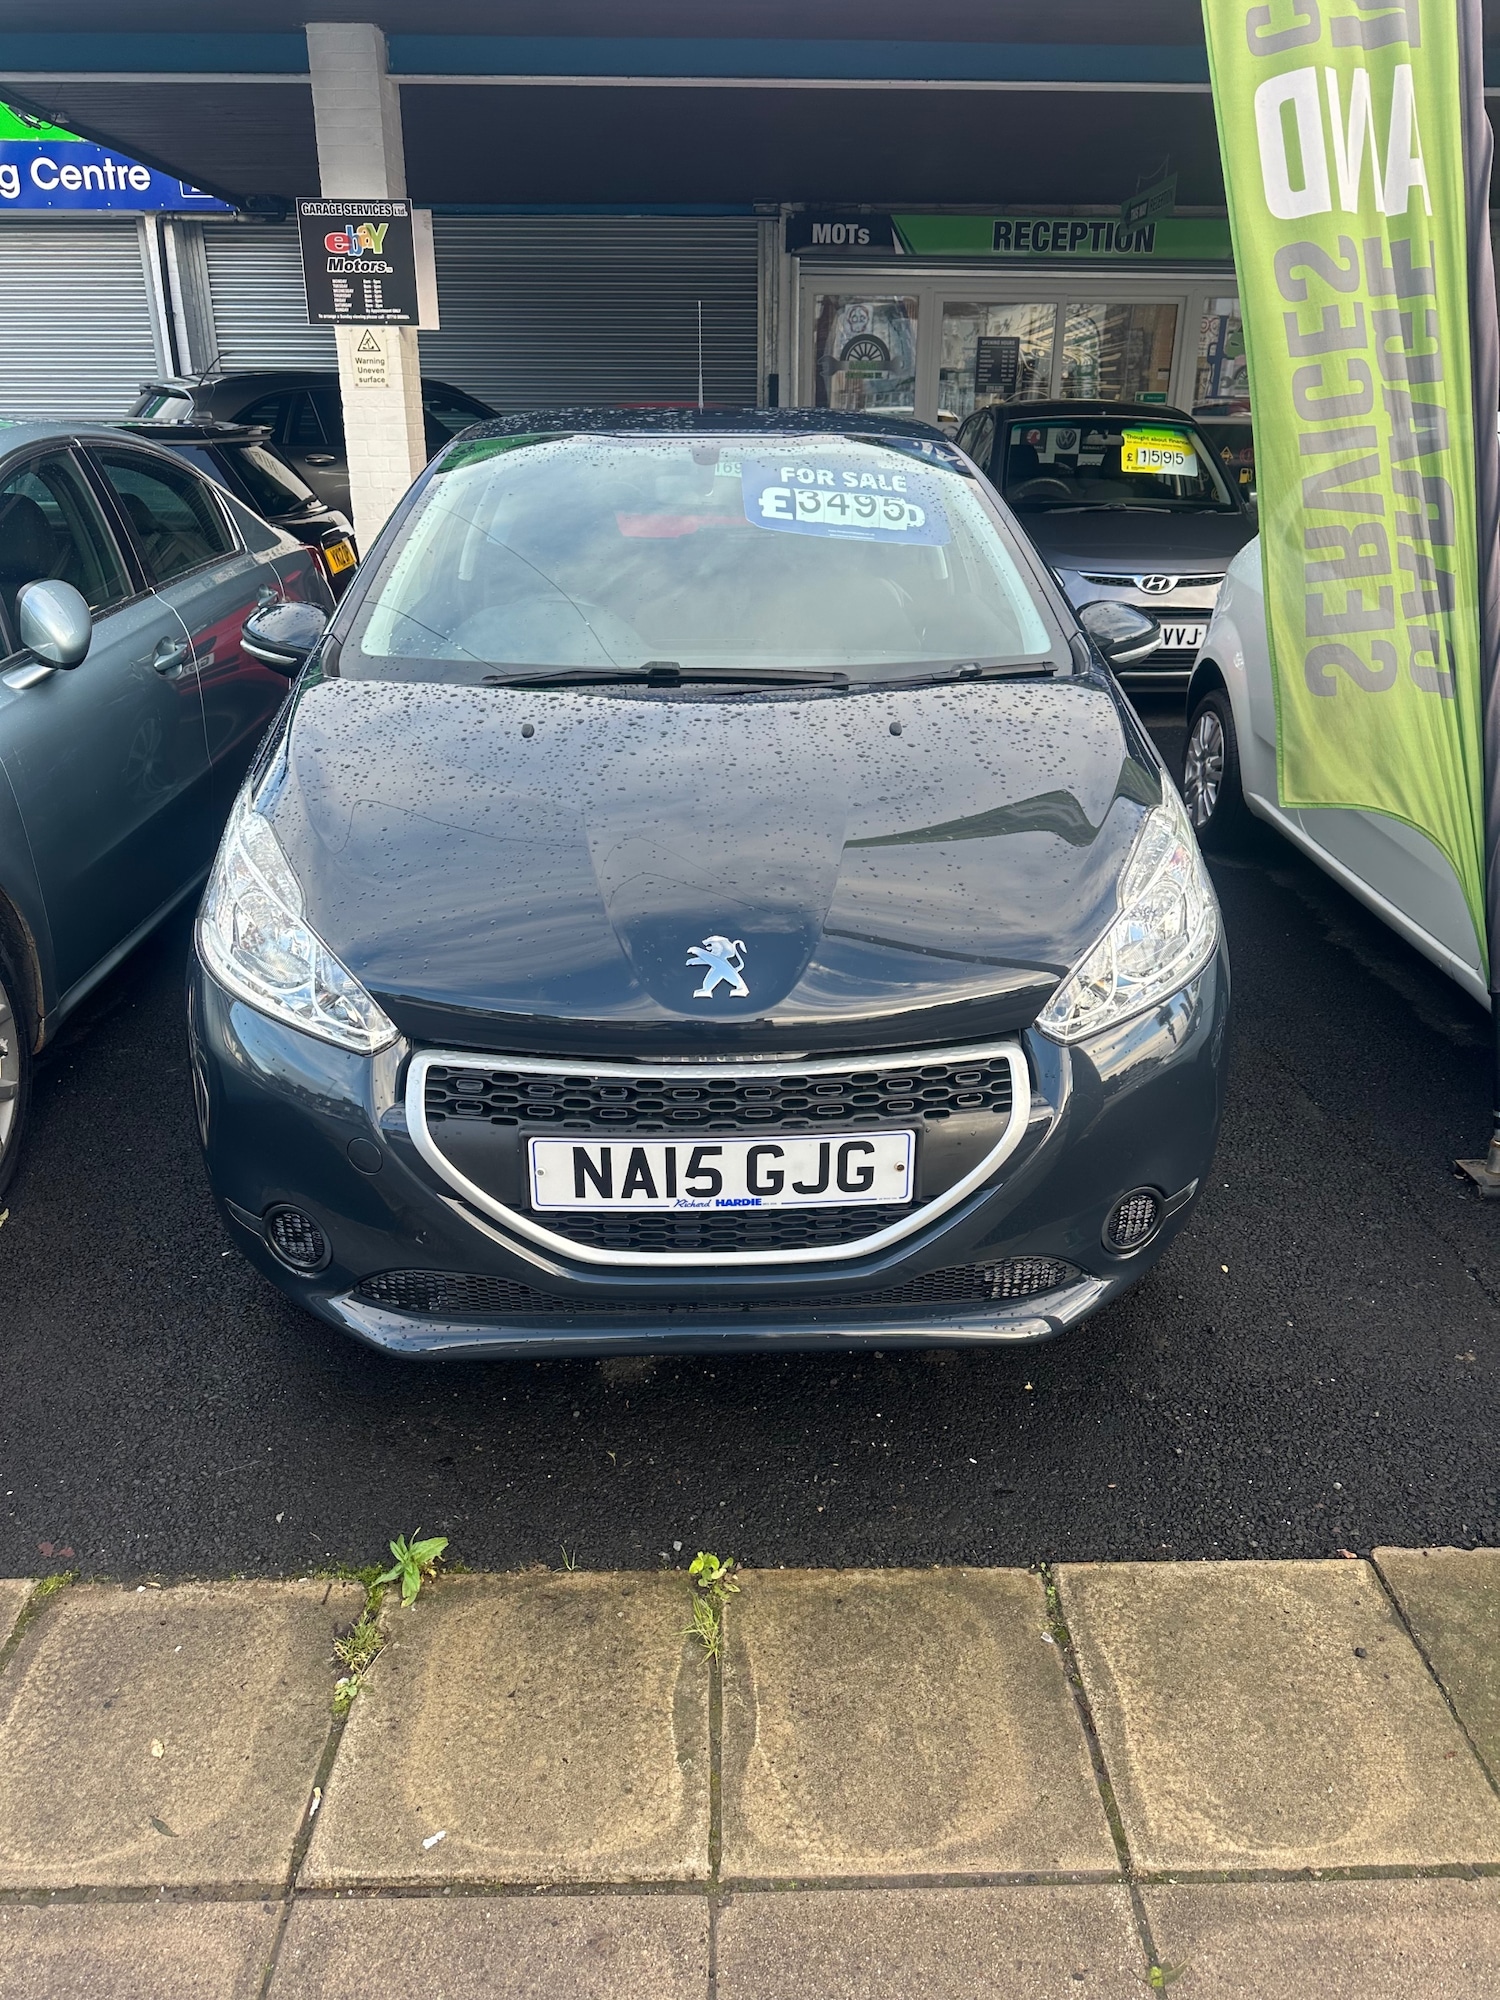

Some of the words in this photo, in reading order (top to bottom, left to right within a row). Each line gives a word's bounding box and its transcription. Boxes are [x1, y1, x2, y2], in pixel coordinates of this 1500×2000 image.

[30, 156, 151, 191] Centre
[301, 203, 343, 216] GARAGE
[344, 203, 391, 217] SERVICES
[812, 223, 870, 245] MOTs
[993, 220, 1157, 253] RECEPTION
[327, 257, 387, 273] Motors
[355, 357, 385, 366] Warning
[780, 466, 835, 486] FOR
[841, 471, 907, 493] SALE
[1163, 628, 1199, 645] VVJ
[572, 1146, 723, 1200] NA15
[746, 1140, 875, 1197] GJG
[673, 1199, 712, 1208] Richard
[715, 1198, 762, 1207] HARDIE
